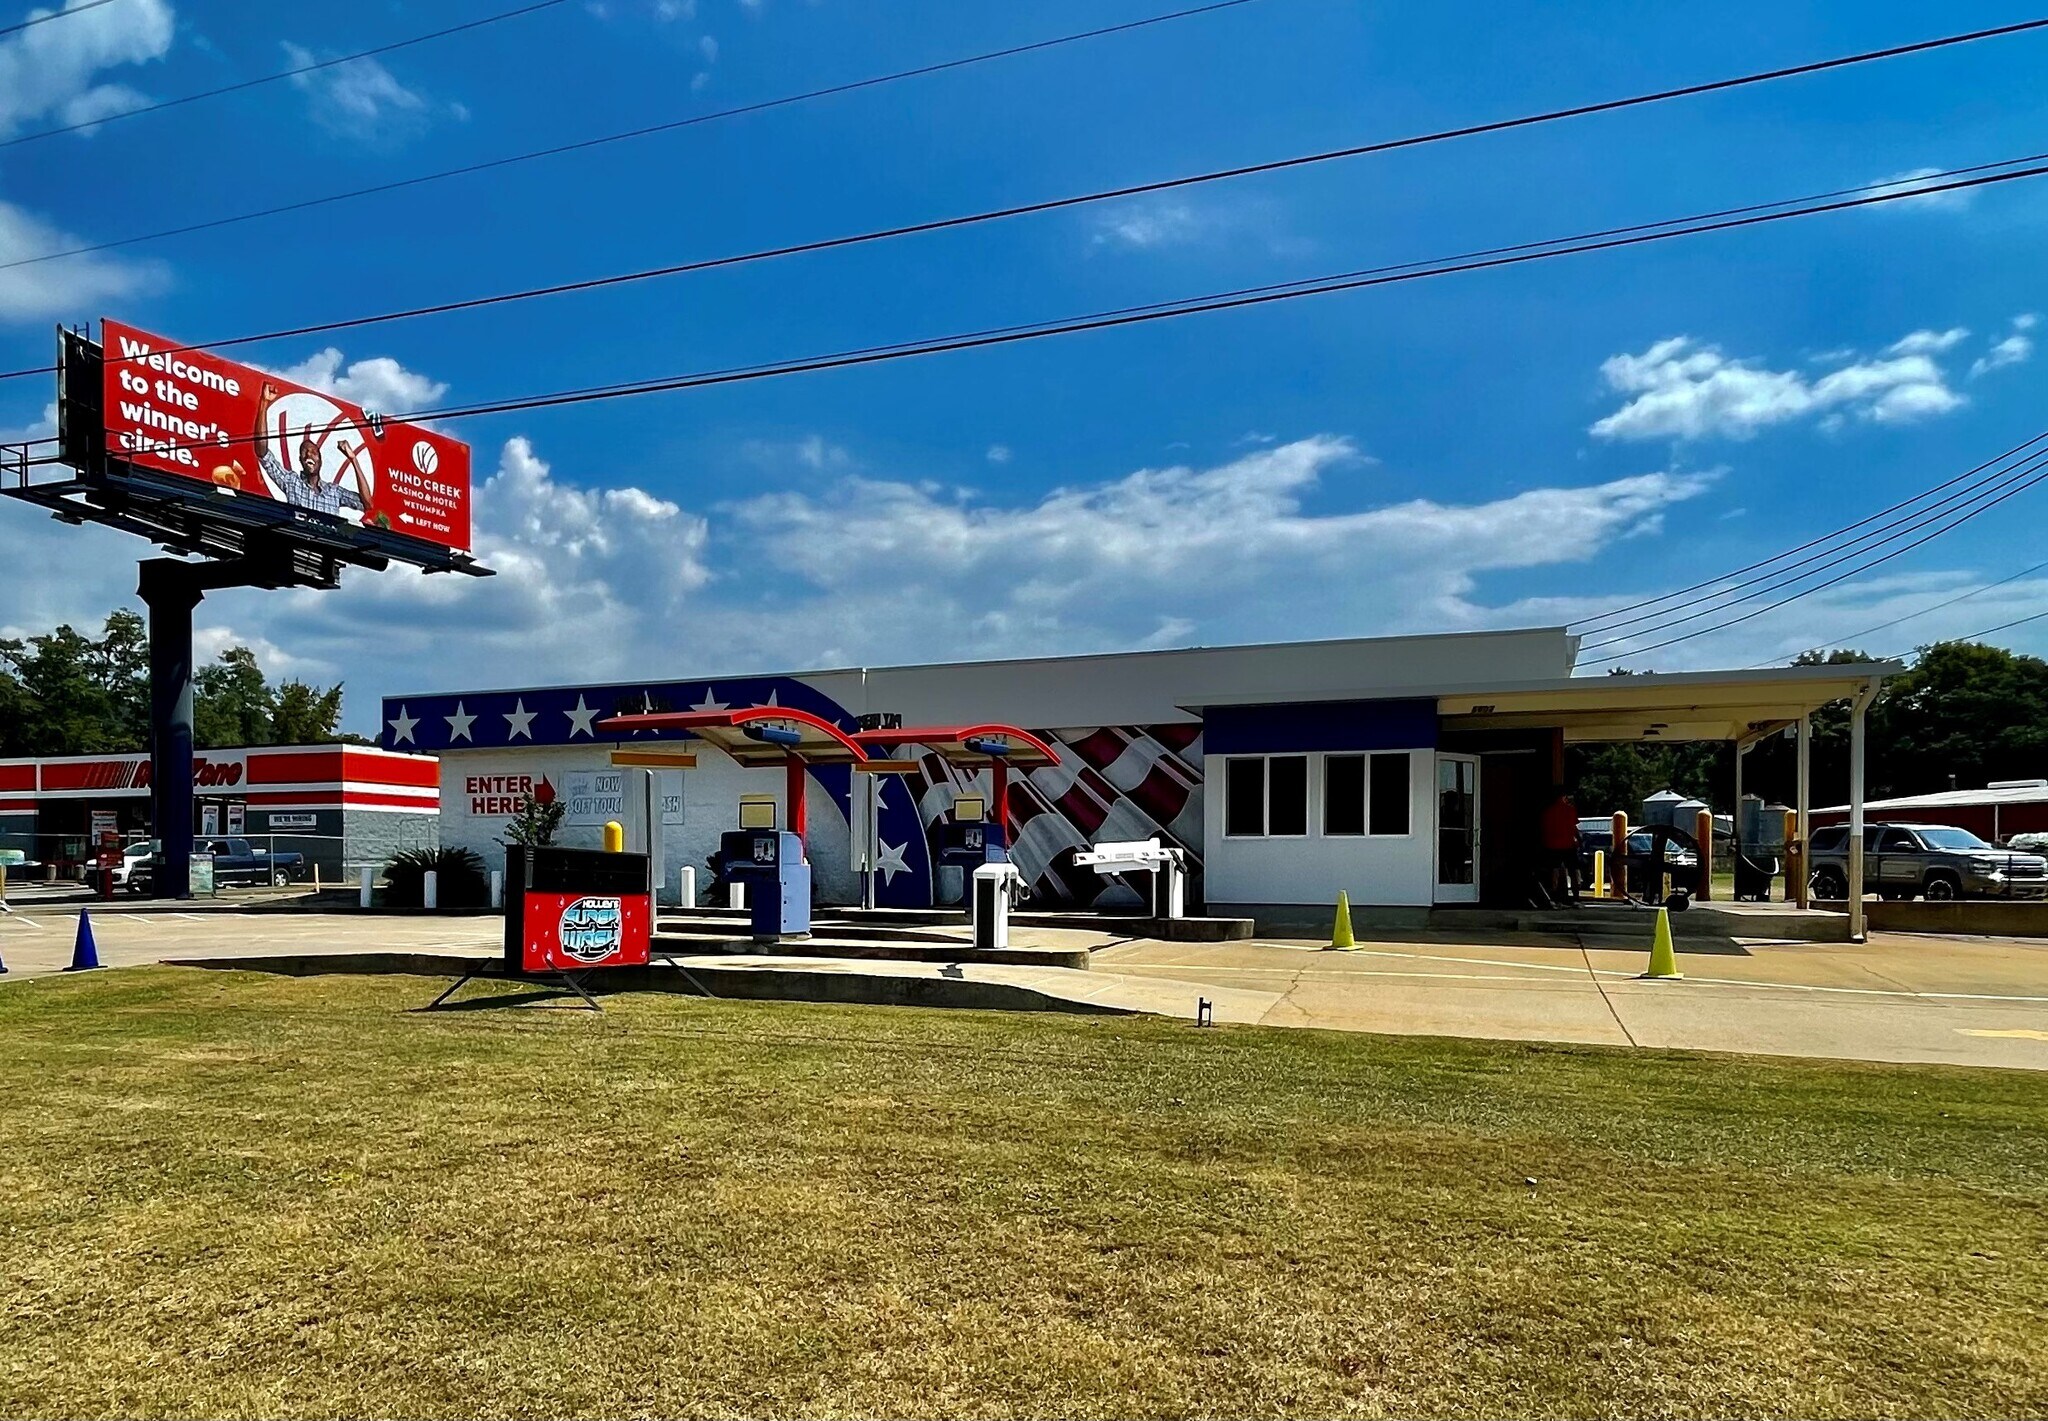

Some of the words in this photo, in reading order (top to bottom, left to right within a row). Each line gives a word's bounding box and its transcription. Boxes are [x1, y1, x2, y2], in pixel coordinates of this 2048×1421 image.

[119, 335, 241, 396] Welcome
[119, 369, 149, 394] to
[155, 380, 198, 410] the
[119, 401, 230, 448] winner's
[119, 428, 199, 467] circle.
[388, 467, 420, 487] WIND
[423, 480, 461, 499] CREEK
[391, 484, 424, 499] CASINO
[432, 496, 458, 509] HOTEL
[403, 499, 446, 517] WETUMPKA
[415, 518, 431, 528] LEFT
[432, 524, 450, 533] NOW
[131, 758, 243, 788] AZone
[466, 776, 532, 793] ENTER
[595, 776, 621, 792] NOW
[472, 797, 525, 814] HERE
[568, 797, 592, 814] SOFT
[594, 797, 623, 813] TOUC
[564, 909, 619, 925] SUPER
[563, 930, 619, 949] WASH
